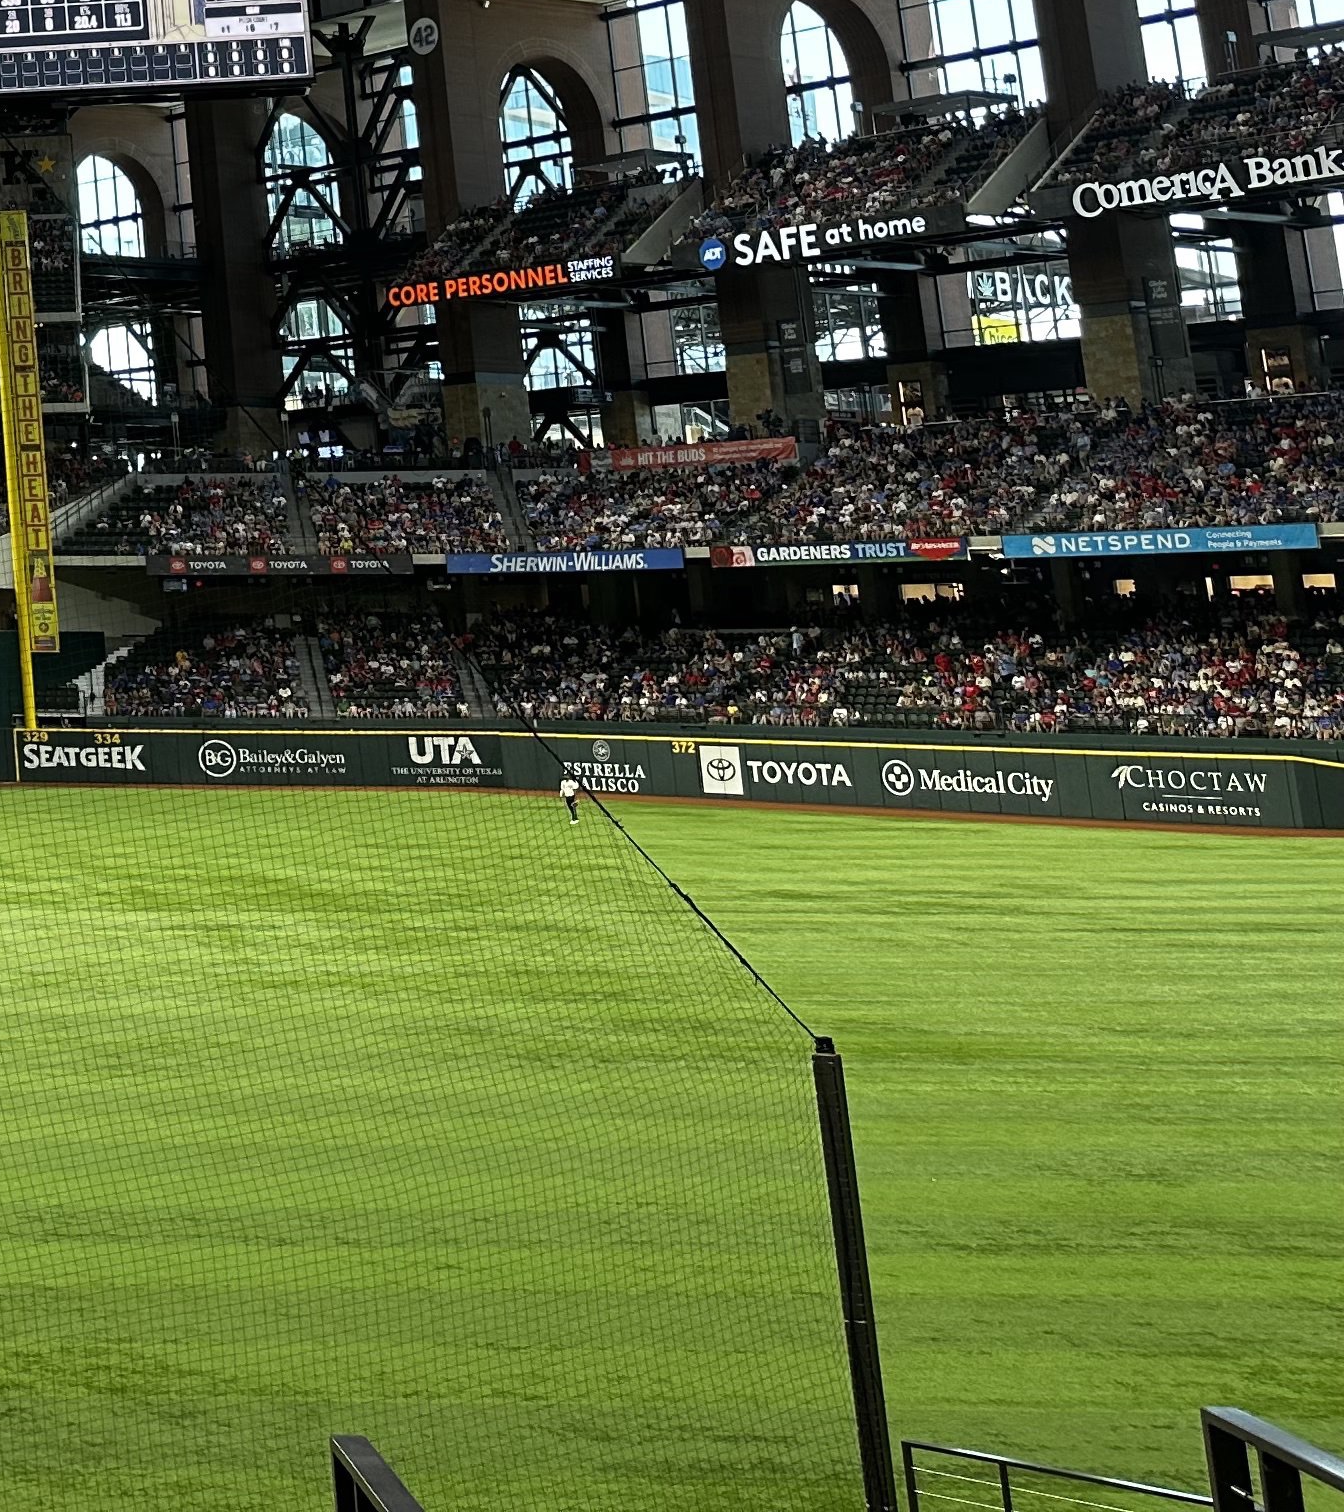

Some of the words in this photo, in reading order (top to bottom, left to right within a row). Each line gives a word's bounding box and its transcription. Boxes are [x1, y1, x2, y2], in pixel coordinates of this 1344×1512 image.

[74, 15, 98, 29] 20.4
[412, 24, 435, 47] 42
[1243, 146, 1343, 189] Bank
[703, 247, 723, 262] ADT
[733, 224, 821, 266] SAFE
[825, 226, 852, 246] at
[857, 216, 926, 240] home
[567, 255, 613, 272] STAFFING
[569, 267, 614, 282] SERVICES
[388, 282, 439, 306] CORE
[445, 264, 568, 299] PERSONNEL
[12, 247, 30, 364] BRING
[20, 374, 36, 444] THE
[637, 453, 653, 466] HIT
[656, 451, 675, 464] THE
[677, 448, 706, 463] BUDS
[25, 453, 43, 549] HEAT
[1062, 533, 1191, 553] NETSPEND
[1206, 530, 1252, 540] Connecting
[756, 544, 851, 561] GARDENERS
[854, 542, 906, 558] TRUST
[189, 561, 226, 570] TOYOTA
[269, 560, 308, 569] TOYOTA
[350, 560, 390, 569] TOYOTA
[23, 731, 49, 742] 329
[93, 733, 121, 745] 334
[408, 736, 482, 764] UTA
[671, 741, 696, 754] 372
[23, 743, 146, 771] SEATGEEK
[239, 766, 301, 774] ATTORNEYS
[307, 766, 319, 774] AT
[326, 766, 347, 774] LAW
[391, 767, 410, 775] THE
[410, 767, 462, 775] UNIVERSITY
[462, 767, 474, 775] OF
[475, 767, 503, 775] TEXAS
[747, 760, 853, 787] TOYOTA
[416, 776, 427, 784] AT
[429, 776, 479, 784] ARLINGTON
[577, 776, 639, 793] ALISCO
[918, 768, 1004, 795] Medical
[1010, 772, 1055, 802] City
[1126, 765, 1267, 793] CHOCTAW
[1142, 802, 1194, 814] CASINOS
[1197, 805, 1205, 814] &
[1207, 805, 1261, 817] RESORTS
